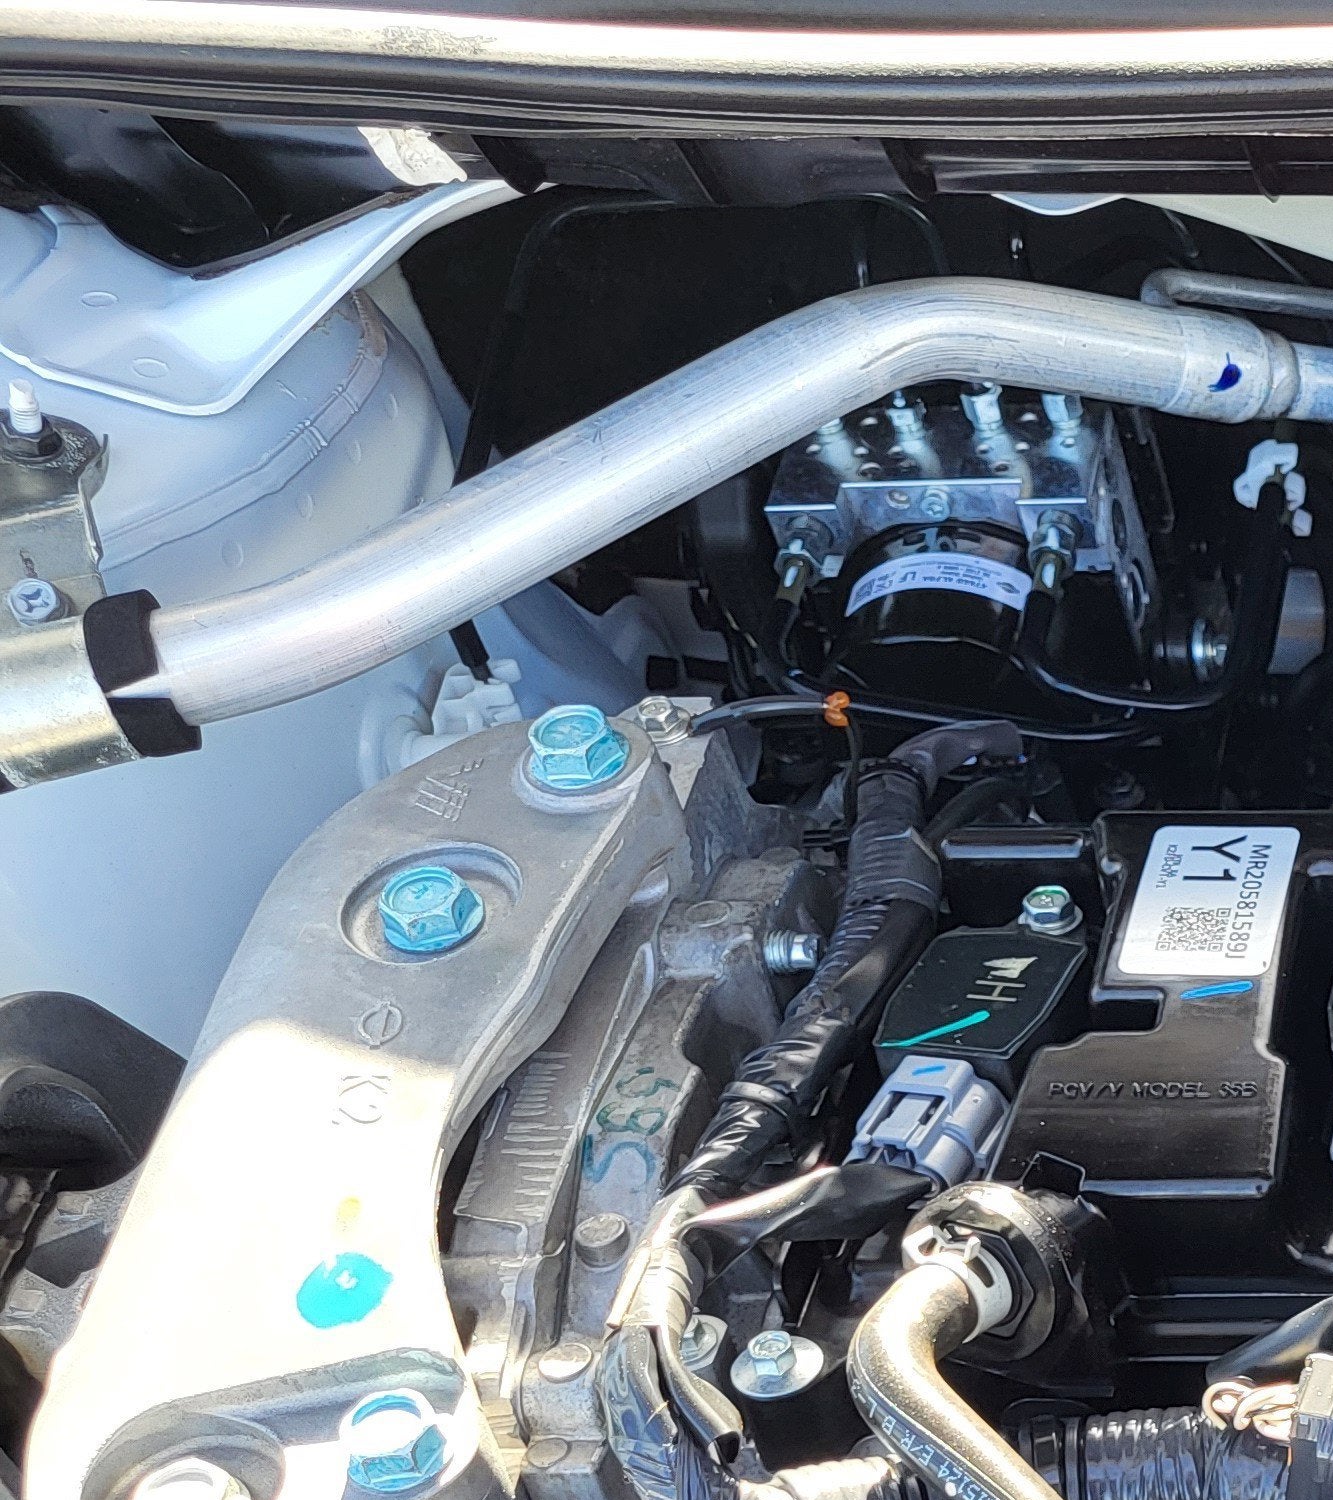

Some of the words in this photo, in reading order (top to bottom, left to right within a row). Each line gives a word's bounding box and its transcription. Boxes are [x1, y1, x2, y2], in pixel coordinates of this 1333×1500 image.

[1182, 834, 1249, 882] Y1
[1225, 844, 1273, 959] MR20581589J
[1131, 1081, 1211, 1099] MODEL
